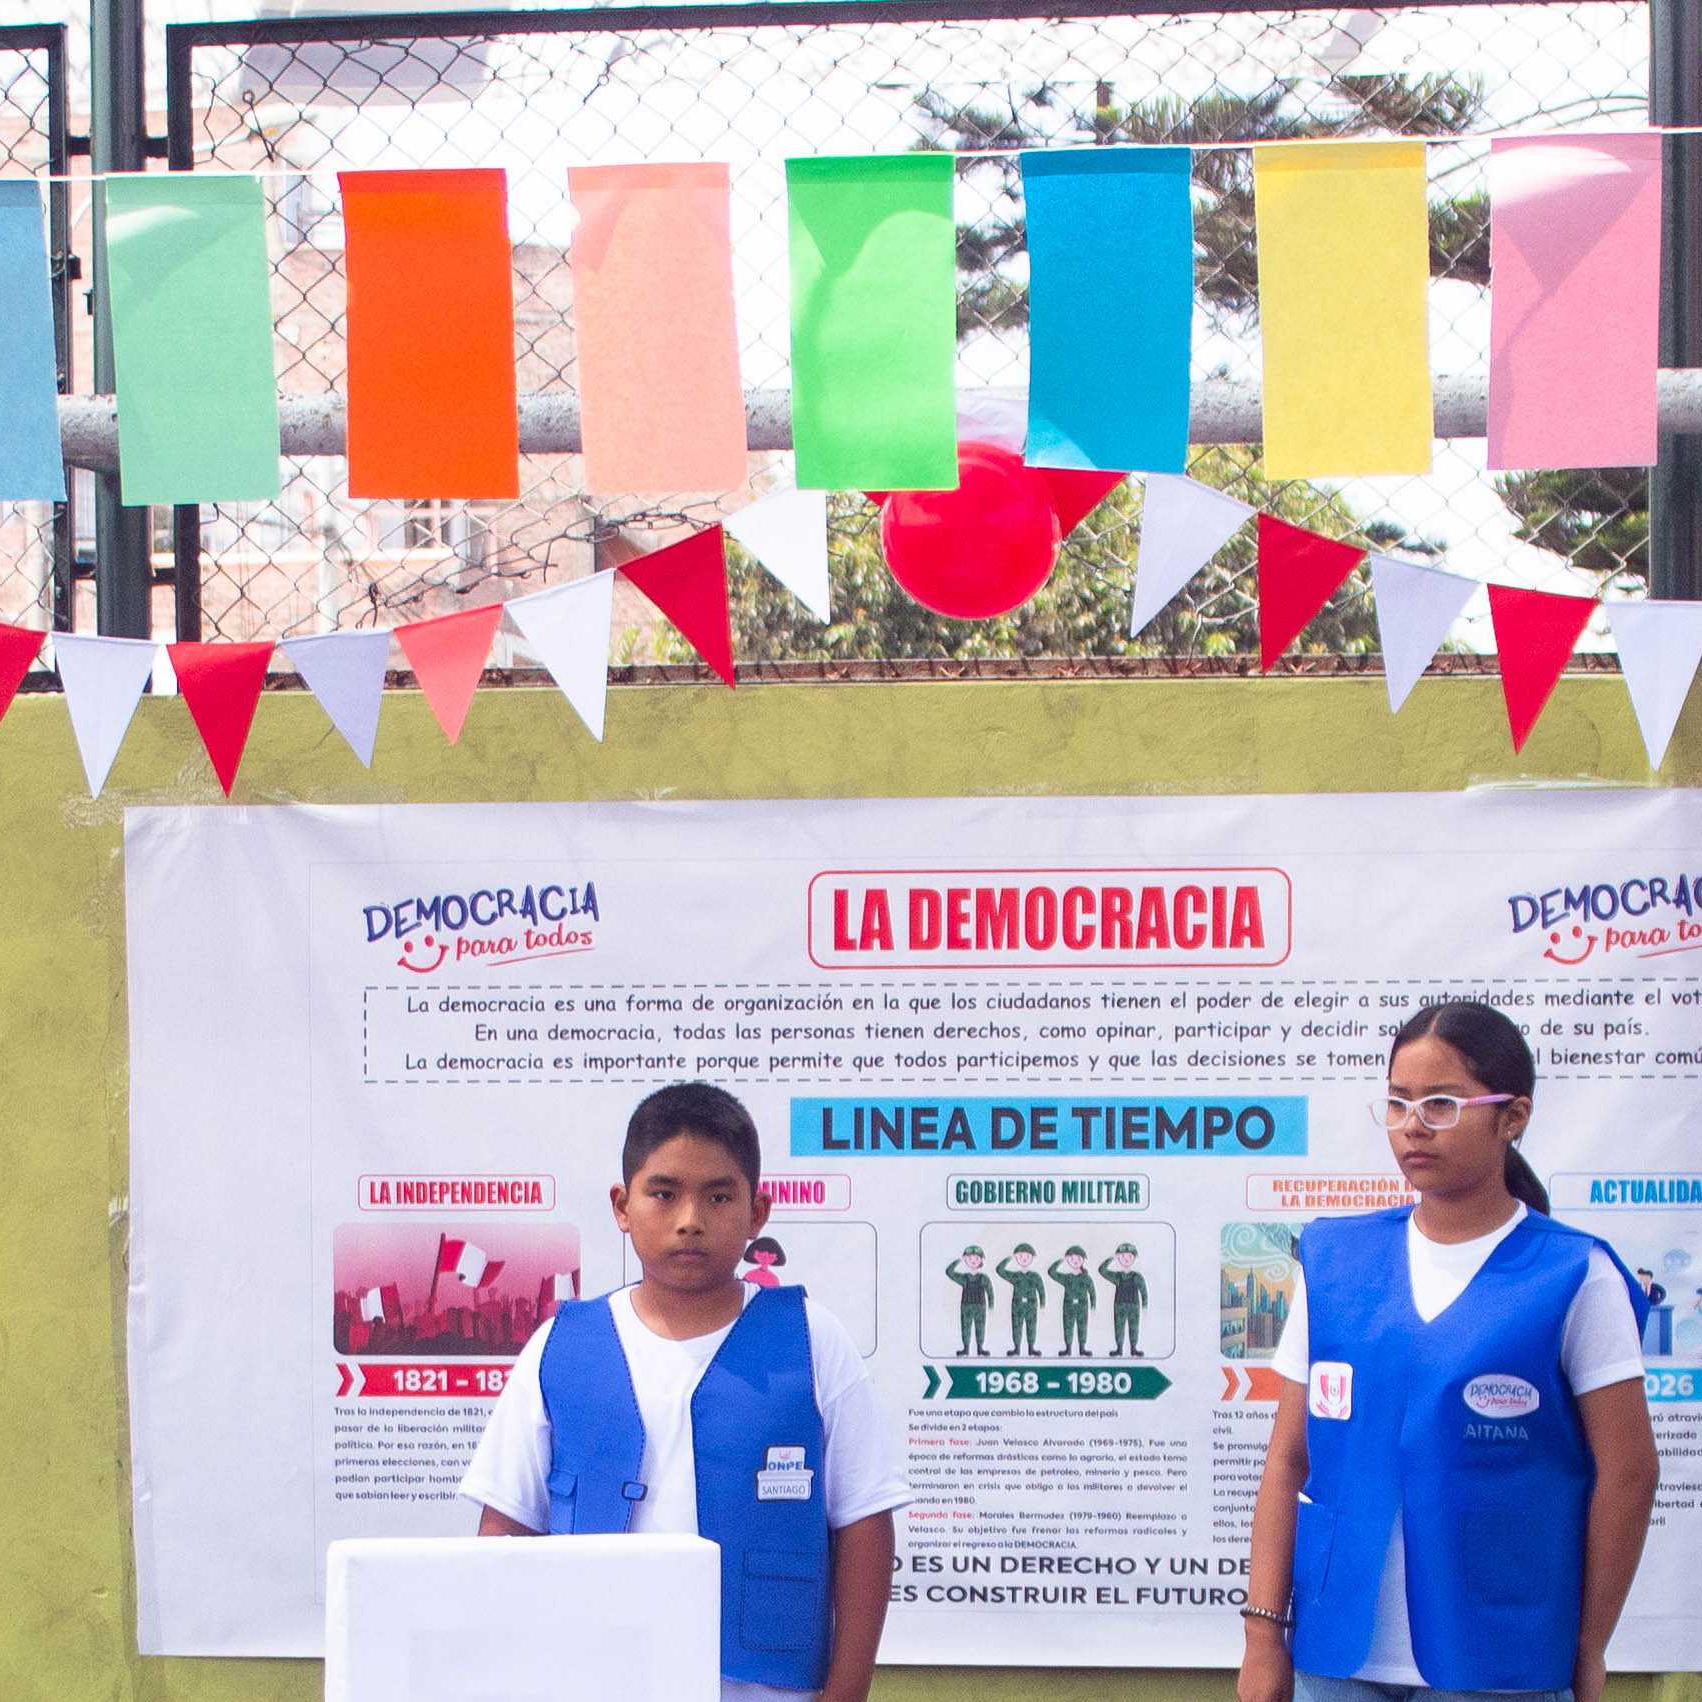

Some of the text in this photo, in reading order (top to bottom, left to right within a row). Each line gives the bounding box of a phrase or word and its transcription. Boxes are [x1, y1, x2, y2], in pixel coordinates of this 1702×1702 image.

[362, 881, 600, 943] DEMOCRACIA
[833, 884, 1266, 952] LA DEMOCRACIA
[455, 924, 594, 962] para todos
[1604, 926, 1671, 956] para
[407, 995, 430, 1014] La
[438, 994, 546, 1014] democracia
[554, 999, 576, 1012] es
[584, 999, 617, 1012] una
[625, 993, 683, 1013] forma
[691, 993, 715, 1012] de
[723, 991, 844, 1016] organización
[851, 997, 875, 1011] en
[883, 992, 900, 1011] la
[908, 997, 942, 1016] que
[951, 991, 978, 1011] los
[986, 991, 1092, 1010] ciudadanos
[1100, 991, 1161, 1010] tienen
[1170, 990, 1187, 1009] el
[1196, 991, 1252, 1015] poder
[1260, 990, 1284, 1009] de
[1293, 990, 1350, 1014] elegir
[1358, 995, 1370, 1008] a
[1379, 993, 1410, 1008] sus
[1544, 987, 1635, 1008] mediante
[1644, 987, 1662, 1006] el
[474, 1016, 1650, 1045] En una democracia, todas las personas tienen derechos, como opinar, participar y decidir de su país.
[405, 1053, 428, 1071] La
[436, 1052, 544, 1071] democracia
[552, 1056, 574, 1070] es
[583, 1052, 687, 1075] importante
[696, 1055, 760, 1074] porque
[768, 1051, 844, 1074] permite
[851, 1055, 885, 1073] que
[893, 1049, 948, 1068] todos
[956, 1050, 1079, 1073] participemos
[1088, 1054, 1100, 1073] y
[1107, 1054, 1142, 1072] que
[1151, 1048, 1178, 1068] las
[1186, 1049, 1287, 1067] decisiones
[1295, 1054, 1317, 1067] se
[1326, 1050, 1386, 1067] tomen
[1550, 1047, 1646, 1066] bienestar
[821, 1100, 1276, 1153] LINEA DE TIEMPO
[369, 1180, 543, 1205] LA INDEPENDENCIA
[955, 1180, 1141, 1205] GOBIERNO MILITAR
[1272, 1177, 1400, 1193] RECUPERACIÓN
[1281, 1194, 1416, 1208] LA DEMOCRACIA
[392, 1368, 448, 1392] 1821
[975, 1370, 1133, 1395] 1968 – 1980
[1469, 1382, 1532, 1398] DEMOCRACIA
[1643, 1373, 1695, 1398] 026
[1464, 1423, 1529, 1441] AITANA
[911, 1555, 944, 1574] ES
[952, 1555, 991, 1574] UN
[1000, 1555, 1137, 1575] DERECHO
[1144, 1557, 1162, 1576] Y
[1169, 1557, 1209, 1576] UN
[926, 1584, 1088, 1605] CONSTRUIR
[1096, 1586, 1130, 1605] EL
